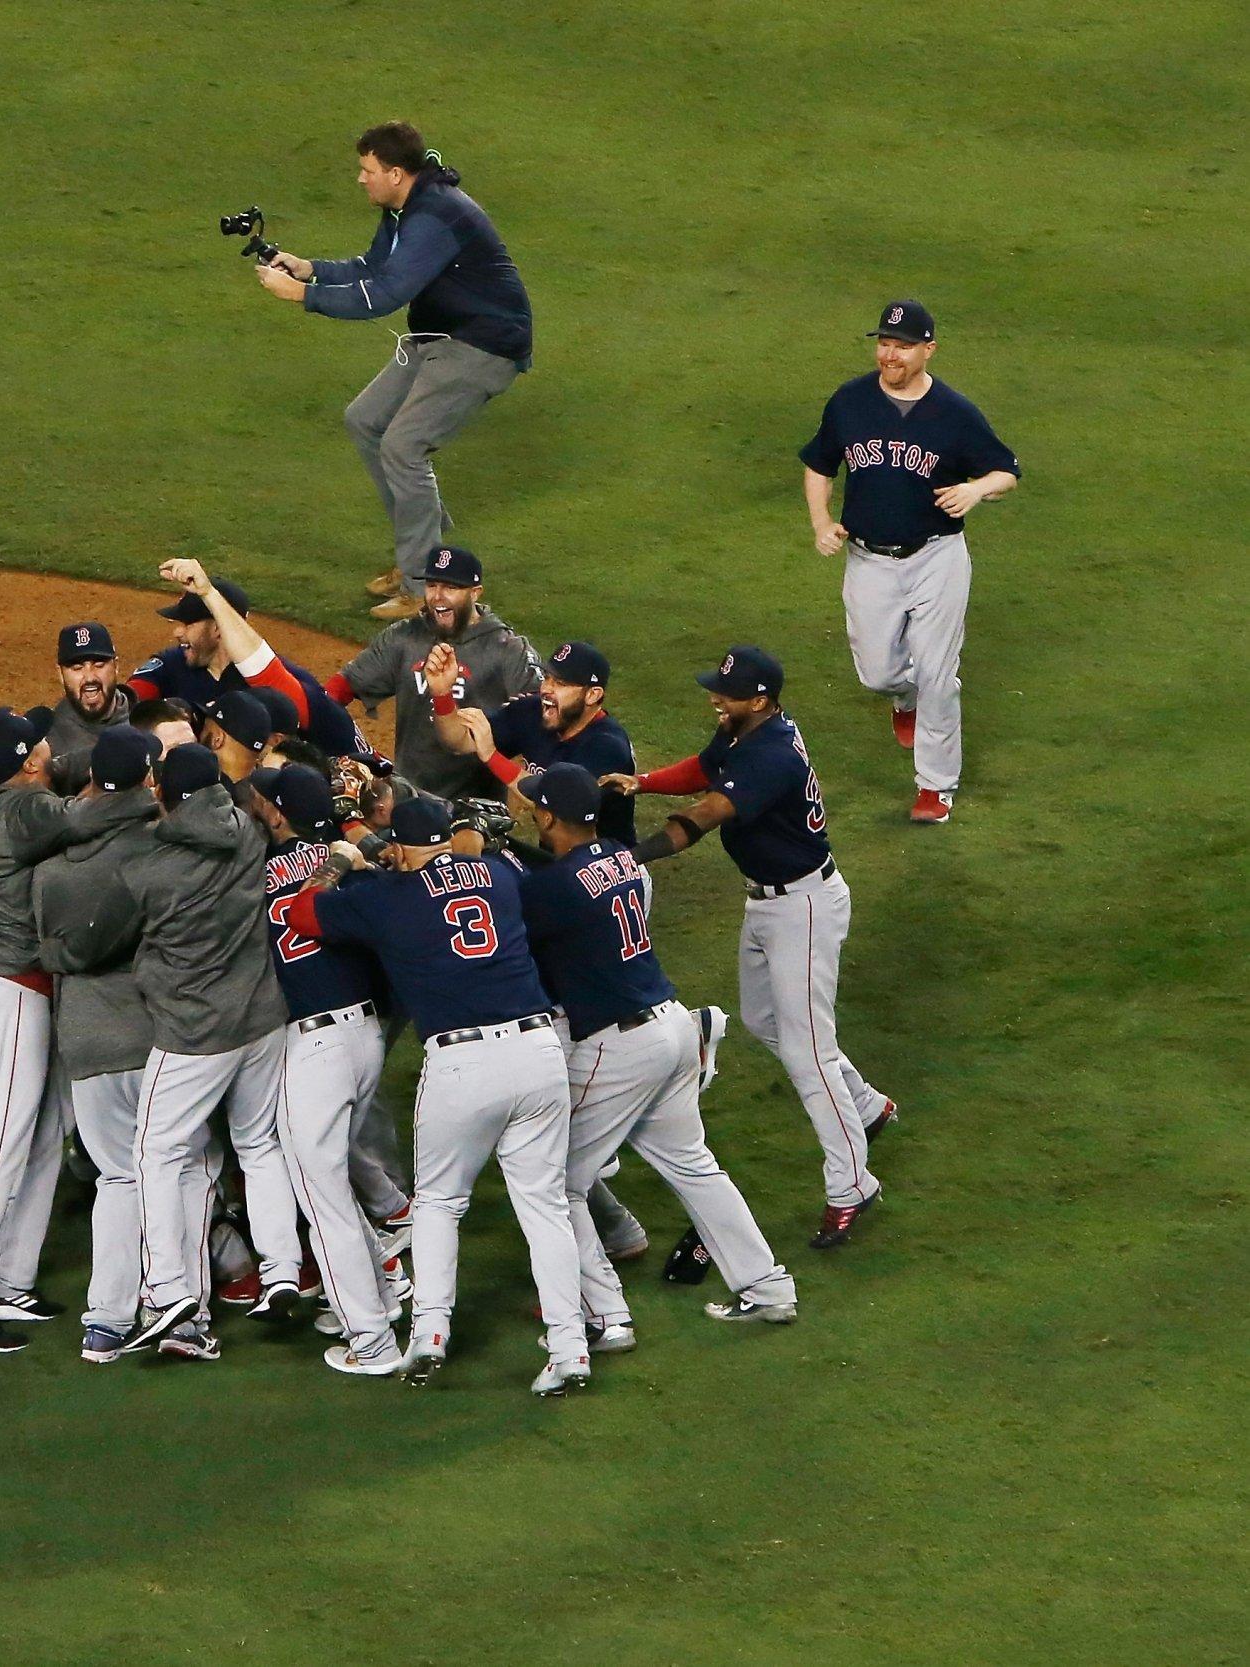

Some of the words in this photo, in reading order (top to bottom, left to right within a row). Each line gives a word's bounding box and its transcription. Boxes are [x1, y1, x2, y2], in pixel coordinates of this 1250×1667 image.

[887, 306, 904, 325] B
[844, 439, 940, 479] BOSTON
[434, 550, 452, 569] B
[74, 627, 91, 647] B
[419, 861, 493, 898] LEON
[442, 895, 499, 960] 3
[611, 889, 652, 962] 11
